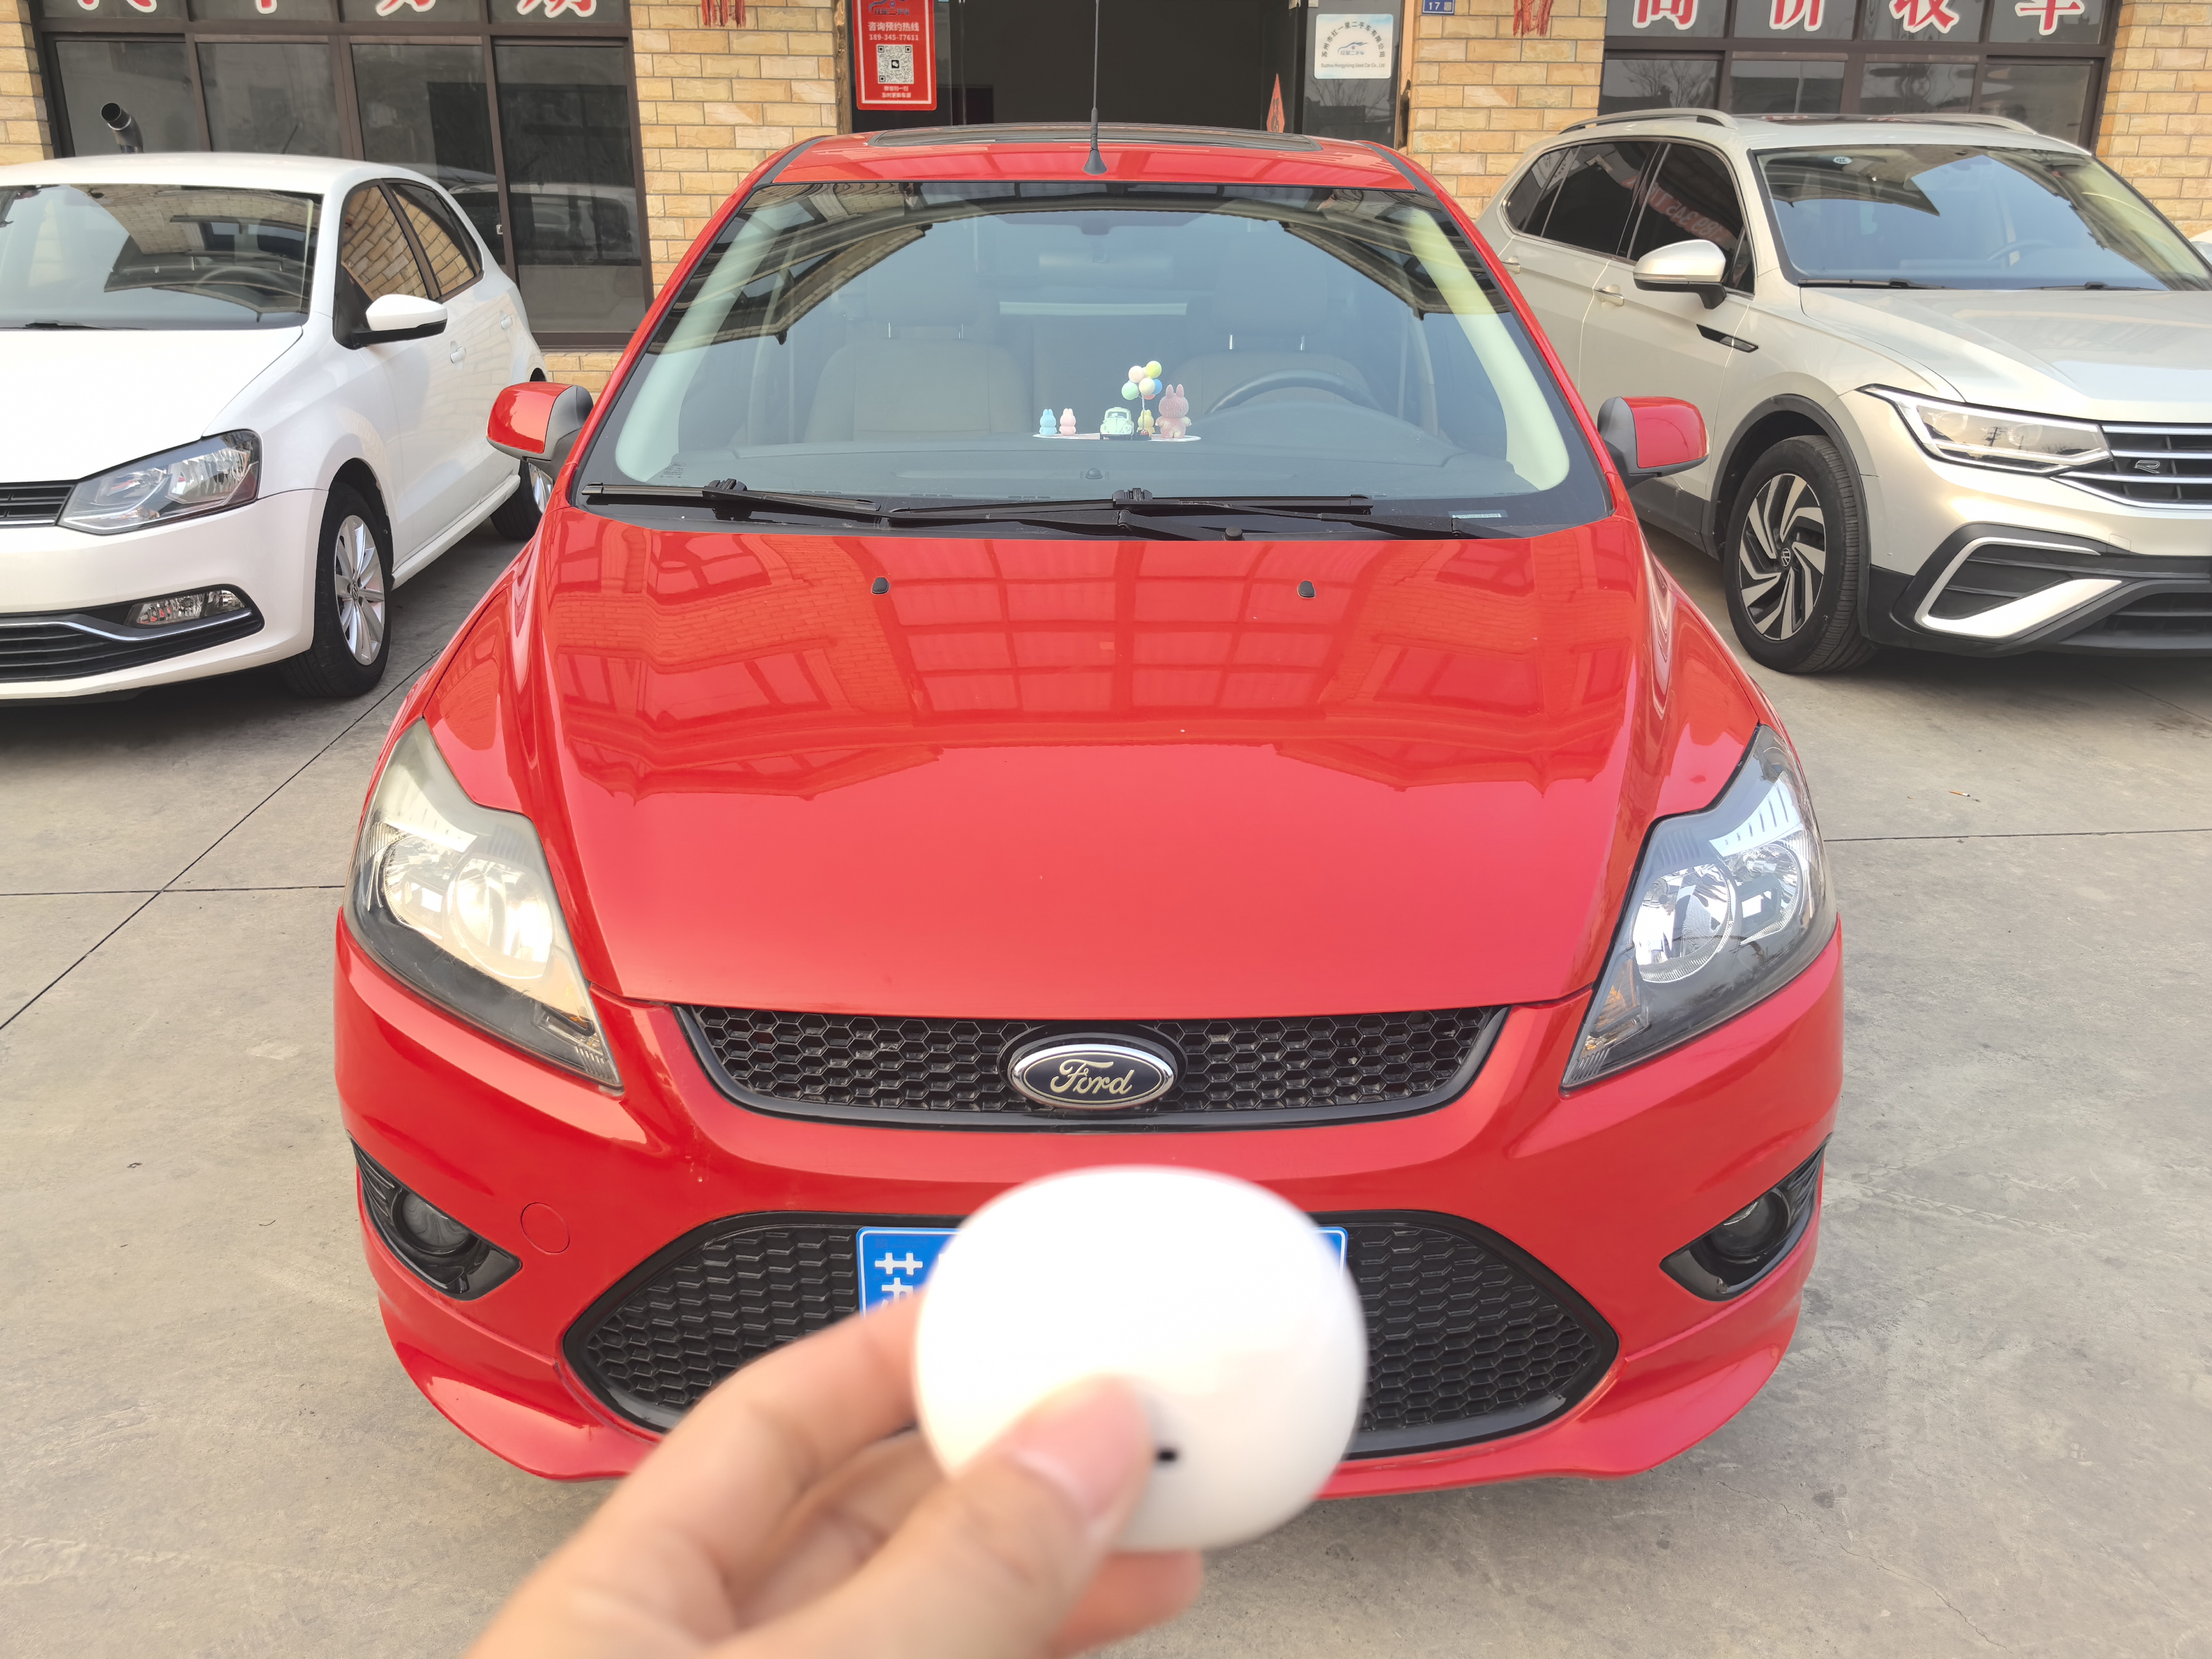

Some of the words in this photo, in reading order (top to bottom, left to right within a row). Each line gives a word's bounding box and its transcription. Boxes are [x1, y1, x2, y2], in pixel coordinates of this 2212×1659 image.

[868, 22, 919, 32] 咨询预约热线
[1321, 22, 1385, 58] 苏州市红一星二手车有限公司
[1050, 1059, 1135, 1095] Ford
